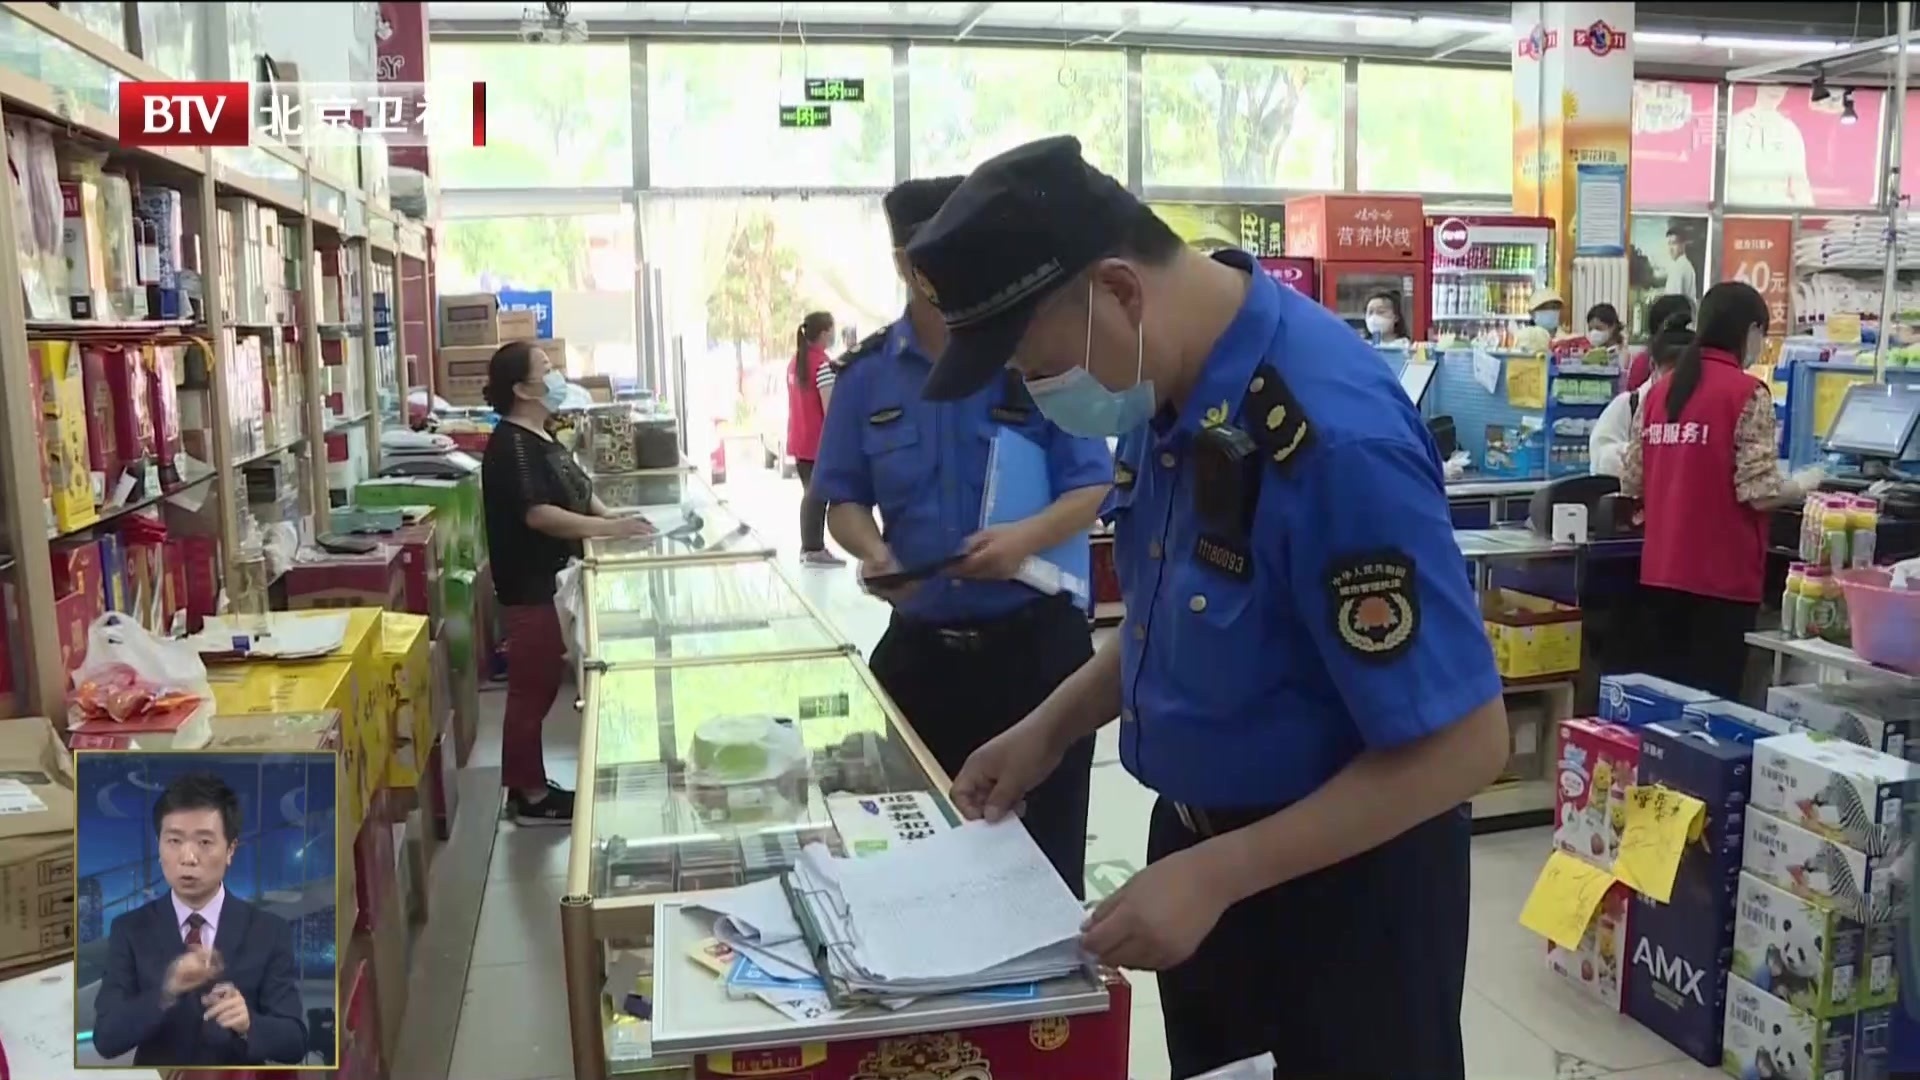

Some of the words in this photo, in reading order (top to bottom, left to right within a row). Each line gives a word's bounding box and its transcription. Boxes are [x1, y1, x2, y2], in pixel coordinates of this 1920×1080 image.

[1337, 223, 1411, 249] 营养快线
[1199, 537, 1244, 574] 11180093
[1632, 935, 1707, 1006] AMX
